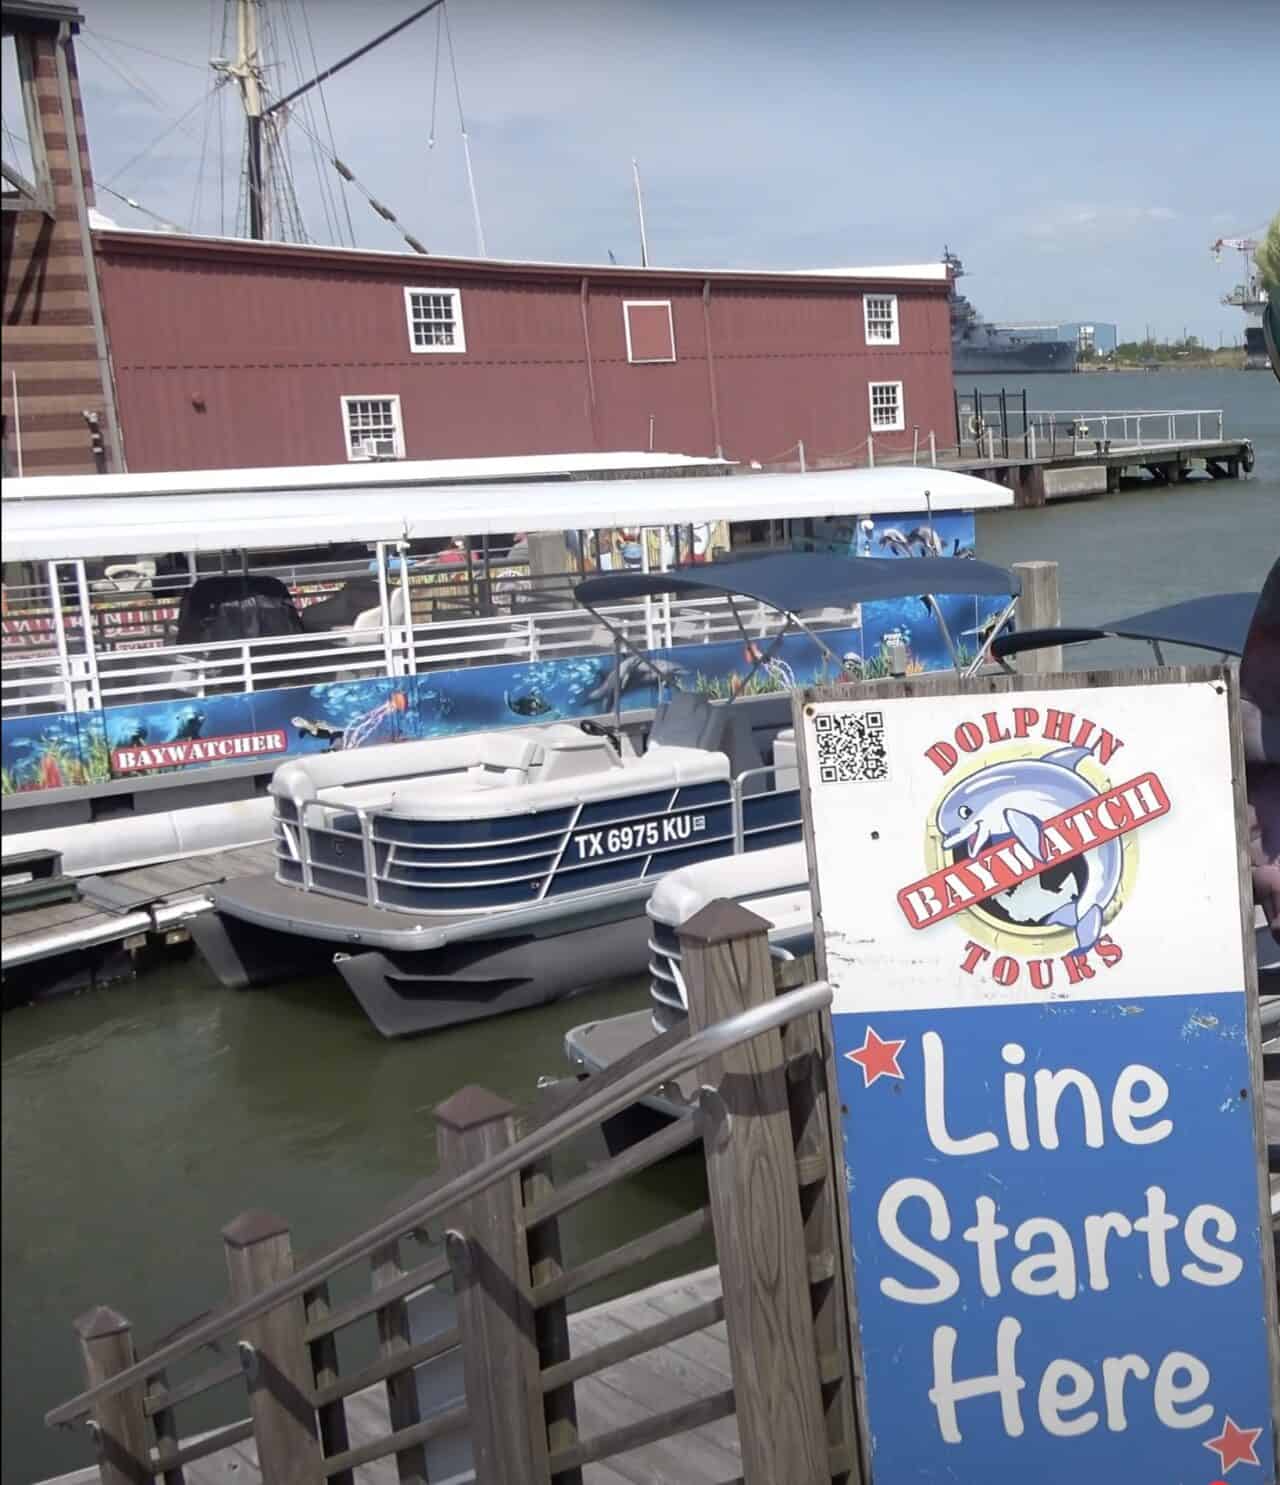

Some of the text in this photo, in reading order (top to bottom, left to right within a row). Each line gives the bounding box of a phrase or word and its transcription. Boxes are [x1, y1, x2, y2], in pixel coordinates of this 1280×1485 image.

[118, 733, 283, 769] BAYWATCHER
[924, 707, 1124, 775] DOLPHIN
[575, 832, 604, 858] TX
[607, 822, 659, 853] 6975
[663, 815, 690, 842] KU
[904, 779, 1162, 924] BAYWATCH
[959, 933, 1124, 990] TOURS
[922, 1031, 1174, 1156] Line
[877, 1177, 1244, 1305] Starts
[928, 1316, 1215, 1444] Here
